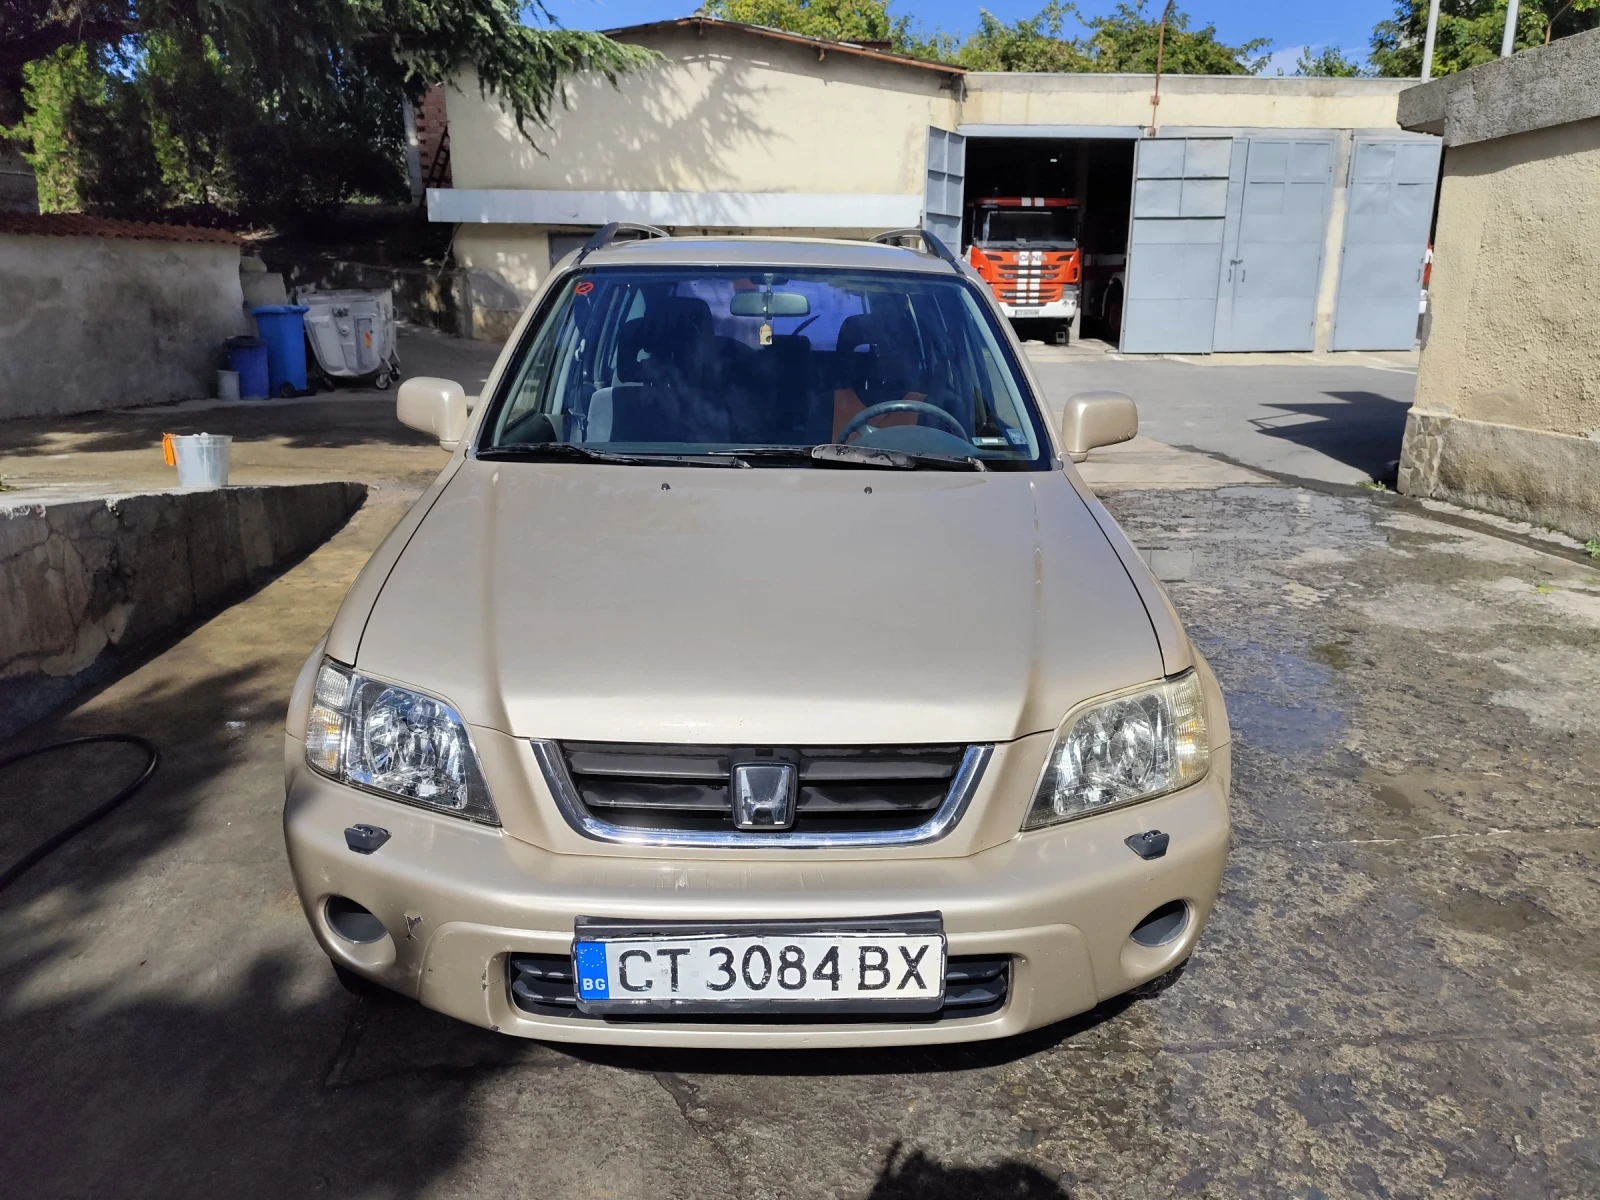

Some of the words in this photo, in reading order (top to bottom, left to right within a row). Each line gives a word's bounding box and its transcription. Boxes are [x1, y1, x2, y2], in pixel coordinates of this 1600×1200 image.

[618, 948, 690, 992] CT
[706, 945, 841, 991] 3084
[857, 944, 930, 990] BX
[582, 977, 606, 991] BG
